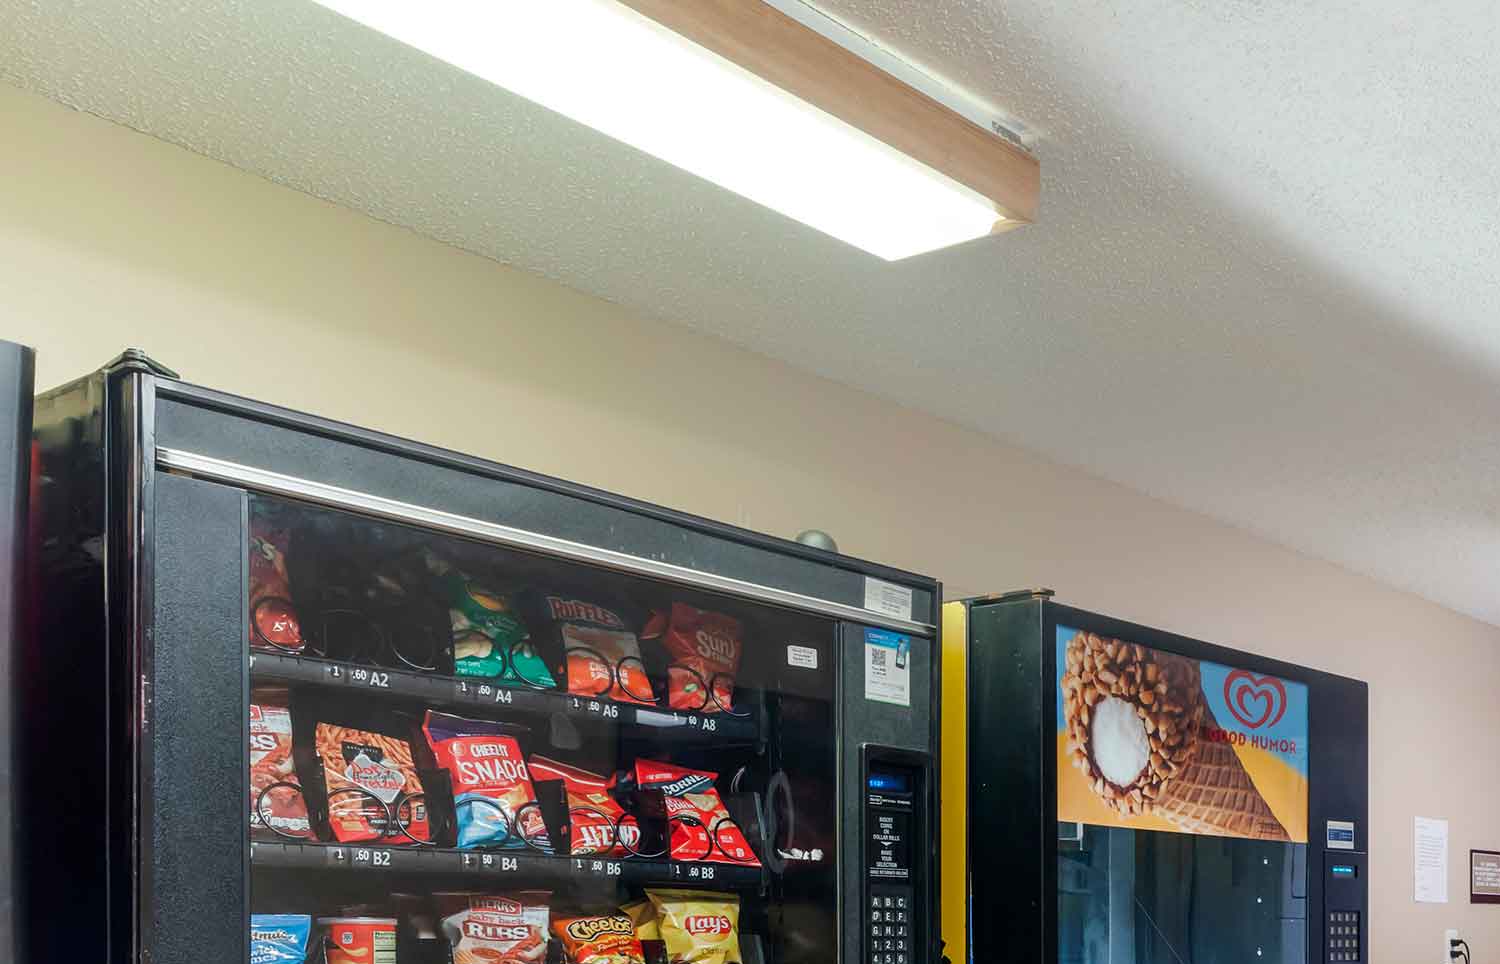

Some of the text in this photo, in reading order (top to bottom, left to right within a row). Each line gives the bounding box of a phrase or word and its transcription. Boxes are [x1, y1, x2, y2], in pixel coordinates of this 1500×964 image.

[370, 672, 389, 686] A2
[496, 690, 512, 703] A4
[603, 705, 618, 718] A6
[702, 719, 716, 731] A8
[1251, 733, 1297, 755] HUMOR
[373, 852, 390, 865] B2
[502, 858, 517, 871] B4
[607, 862, 621, 875] B6
[701, 867, 714, 880] B8
[468, 922, 529, 940] RIBS
[569, 914, 633, 941] Cheetos
